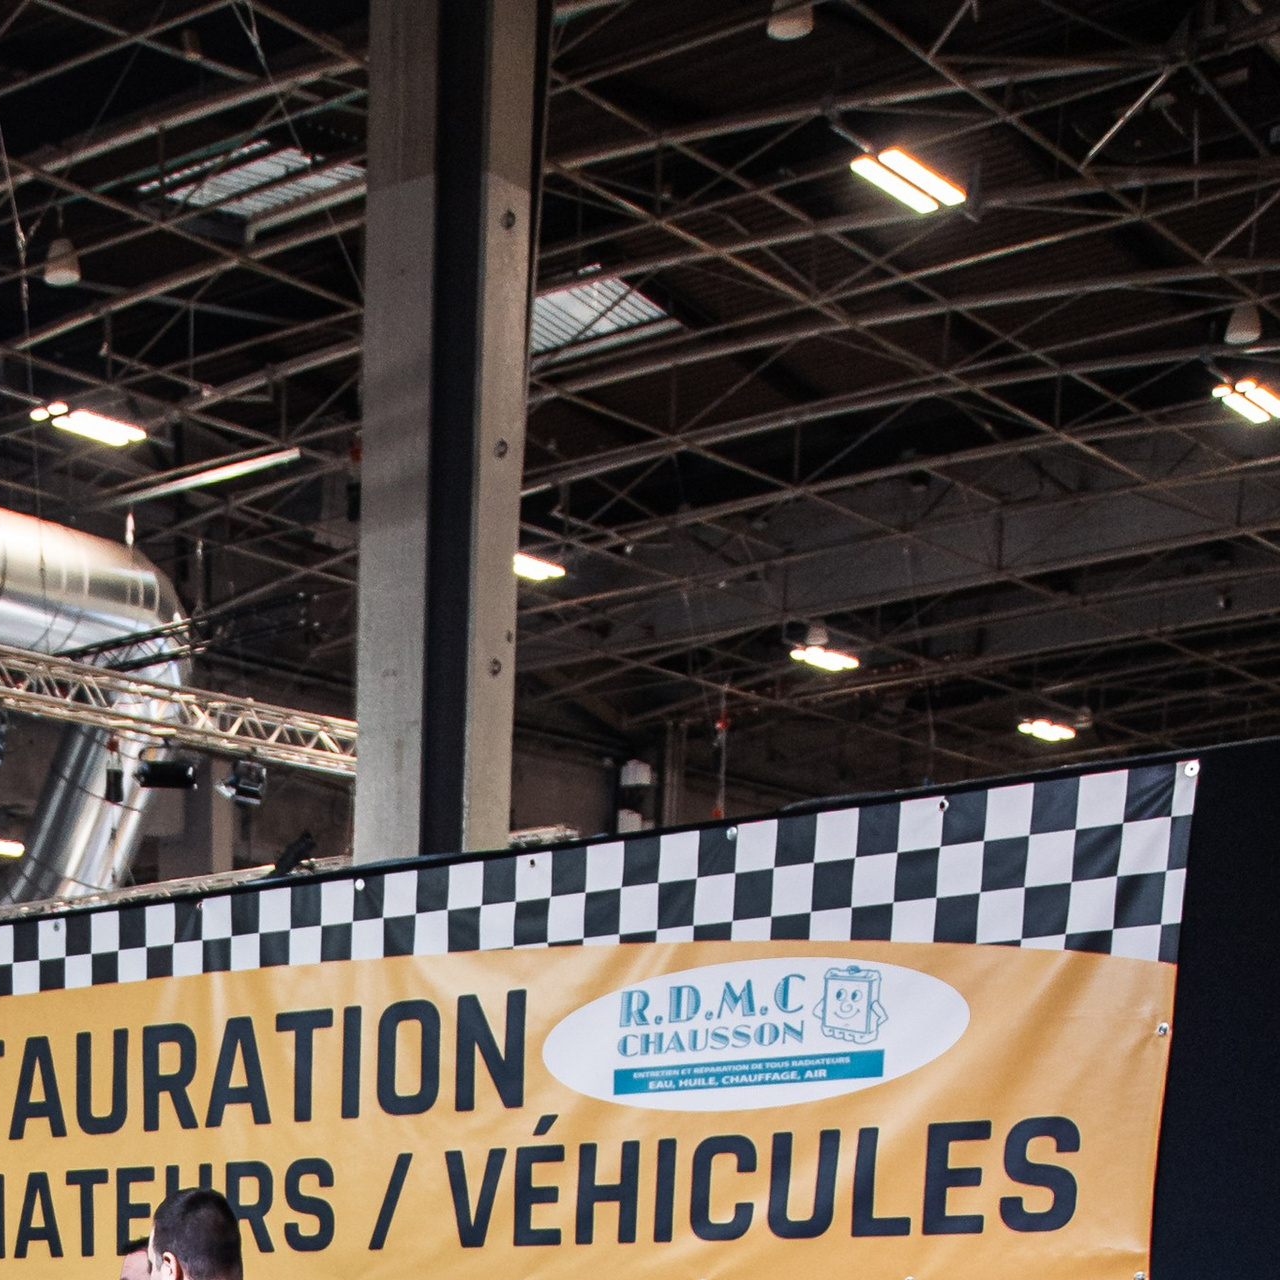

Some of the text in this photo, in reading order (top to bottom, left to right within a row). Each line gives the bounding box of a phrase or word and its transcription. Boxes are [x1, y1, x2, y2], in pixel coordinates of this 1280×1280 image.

[617, 1020, 805, 1058] CHAUSSON
[633, 1069, 679, 1079] ENTRETIEN
[681, 1068, 691, 1076] ET
[765, 1061, 789, 1069] TOUS
[792, 1056, 850, 1067] RADIATEURS
[648, 1069, 828, 1090] EAU, HUILE, CHAUFFAGE, AIR
[369, 1153, 412, 1251] /
[445, 1113, 1081, 1248] VÉHICULES
